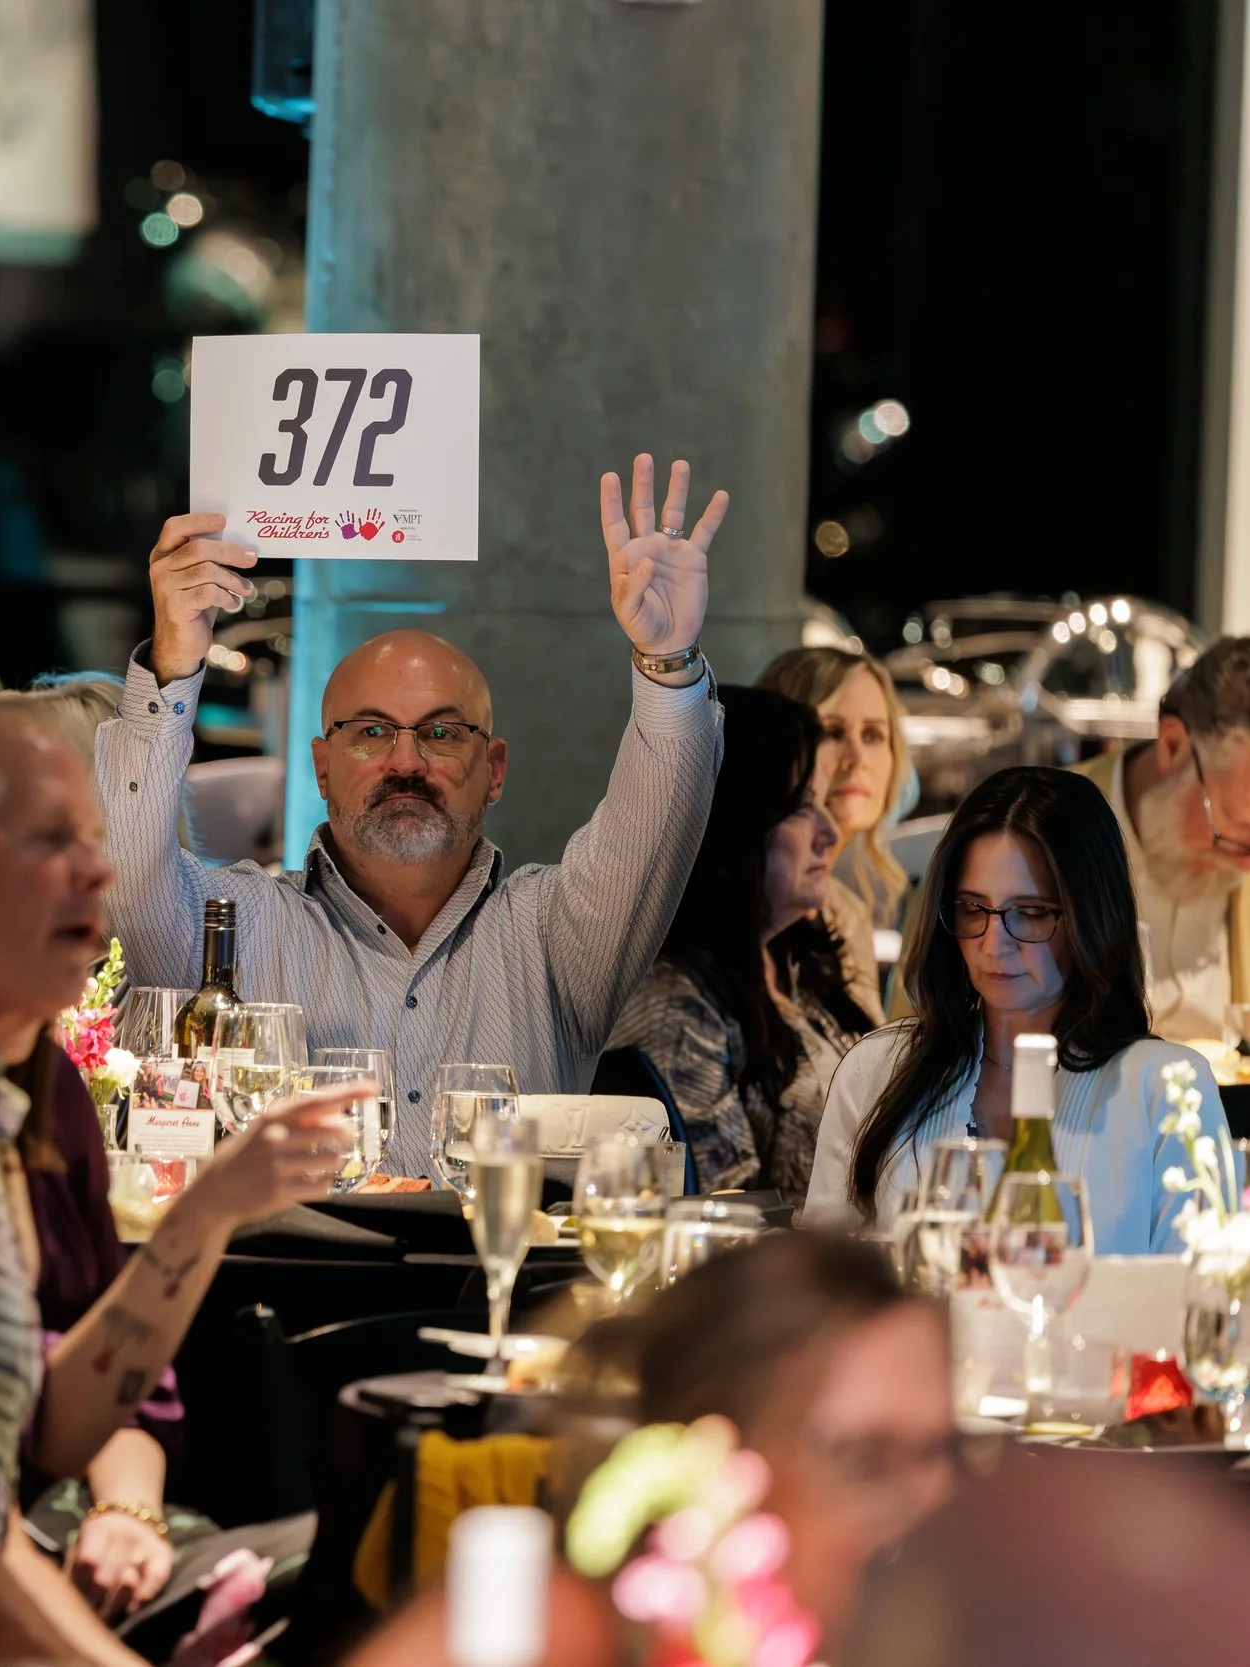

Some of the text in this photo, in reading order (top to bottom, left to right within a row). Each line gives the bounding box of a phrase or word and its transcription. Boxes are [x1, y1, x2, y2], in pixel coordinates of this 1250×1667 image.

[258, 368, 413, 487] 372
[246, 510, 330, 529] Racing for
[257, 524, 330, 539] Children's
